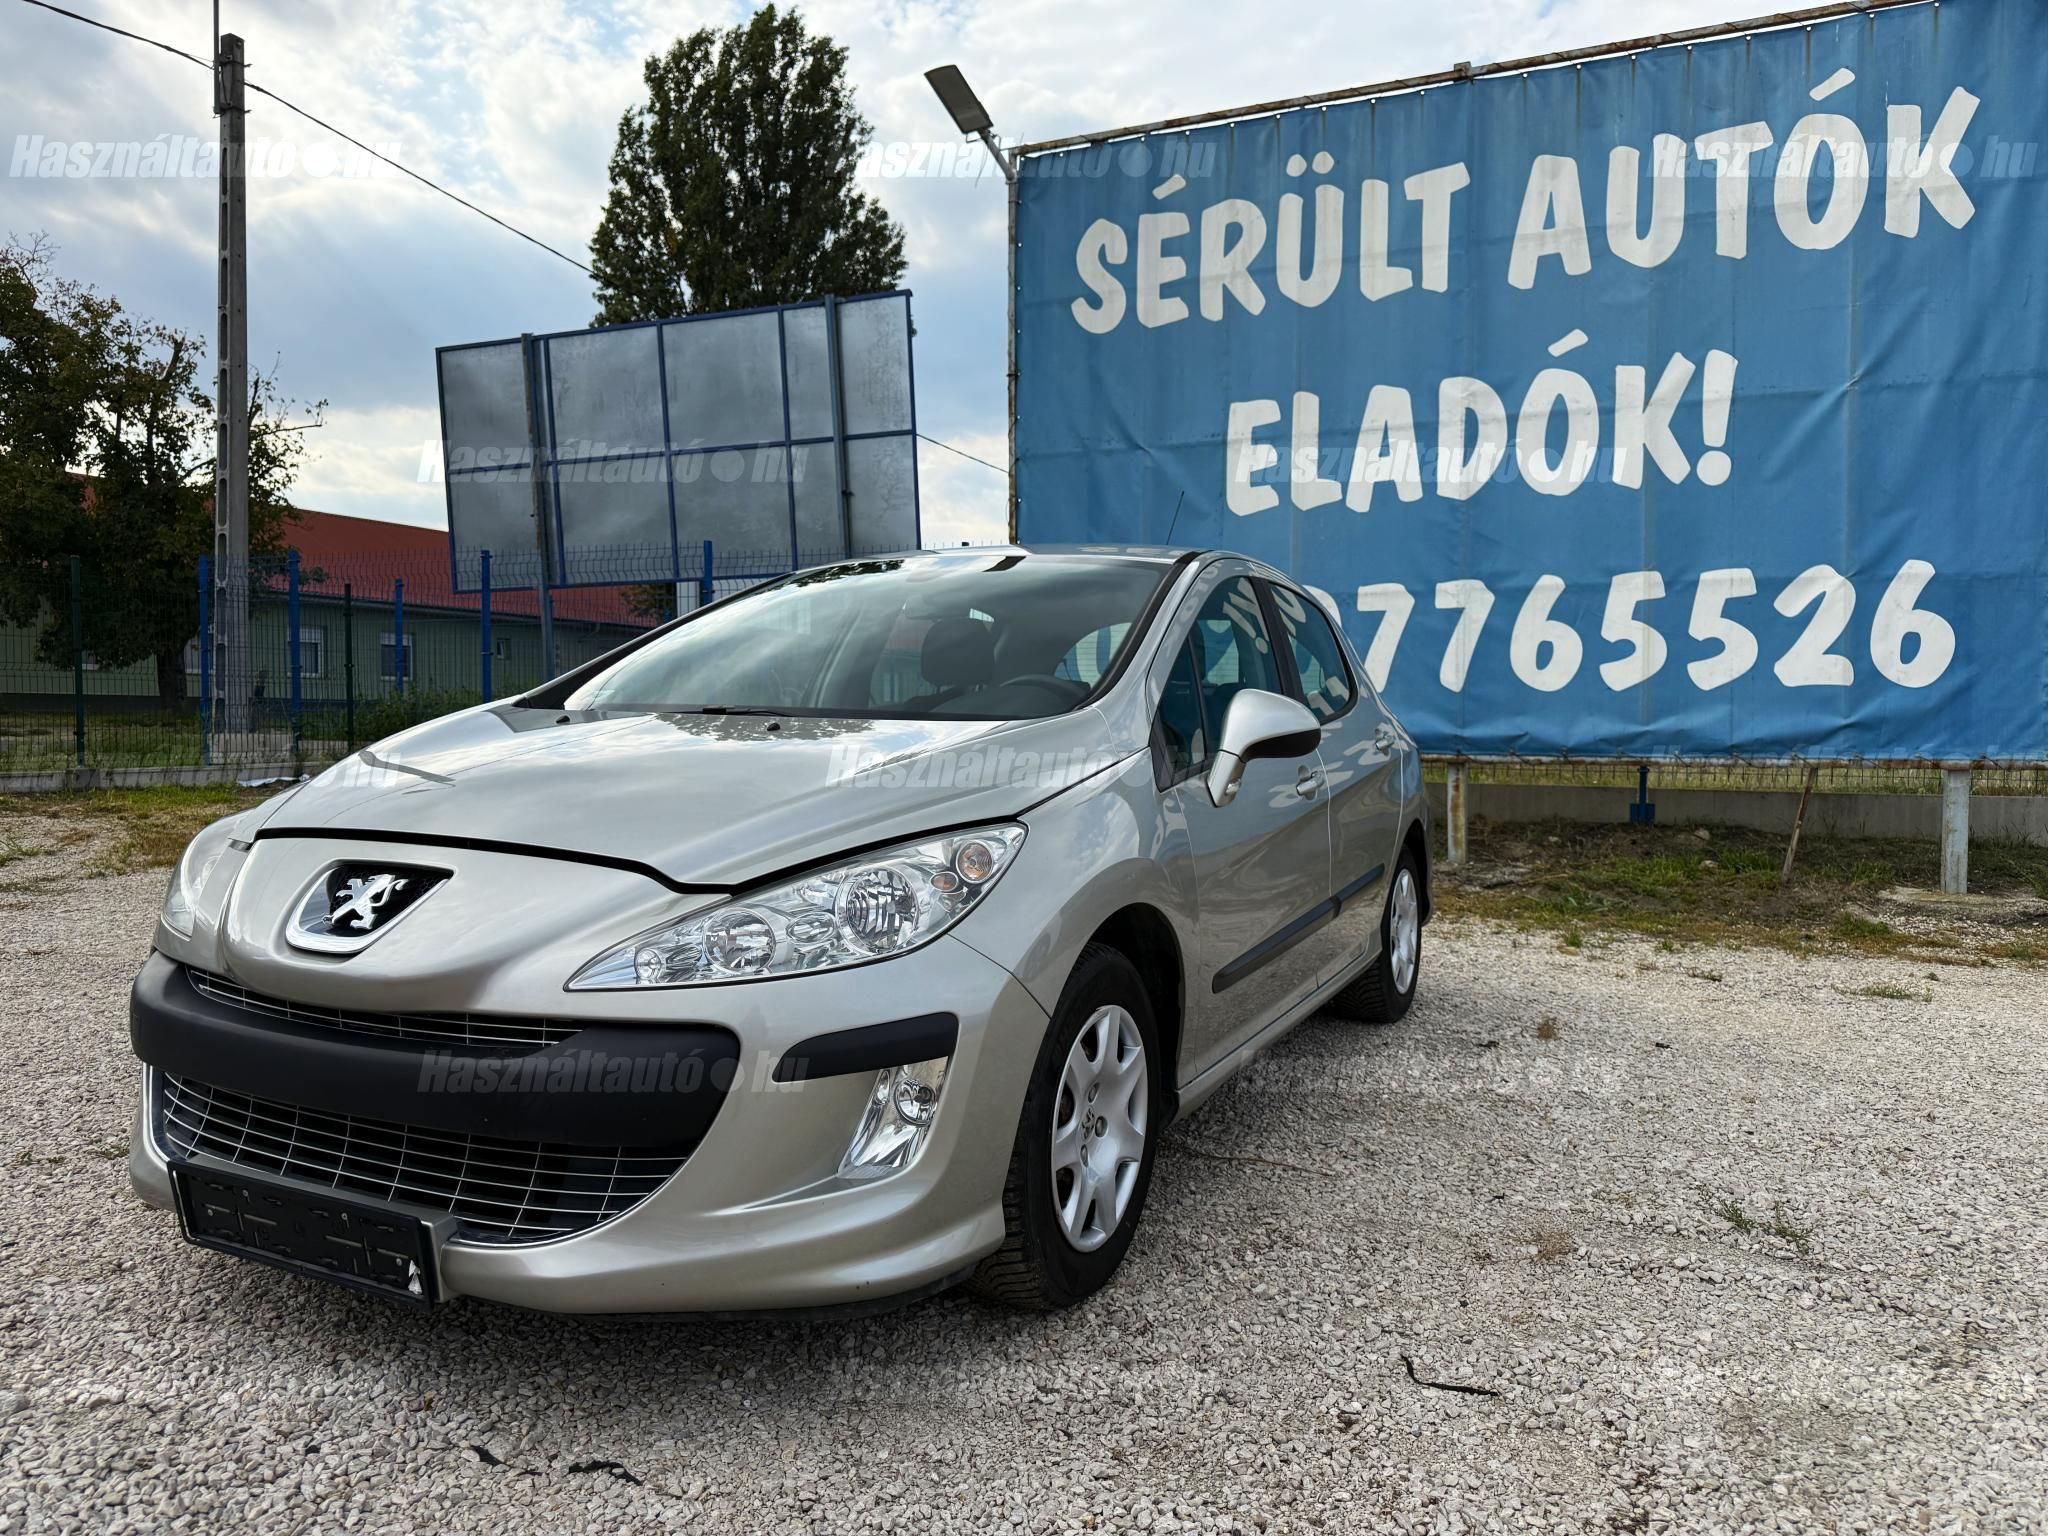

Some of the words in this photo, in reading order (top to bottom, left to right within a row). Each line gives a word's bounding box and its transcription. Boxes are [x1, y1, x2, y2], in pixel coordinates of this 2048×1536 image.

[1071, 151, 1470, 334] SÉRÜLT
[1508, 67, 1980, 290] AUTÓK
[1226, 329, 1739, 517] ELADÓK!
